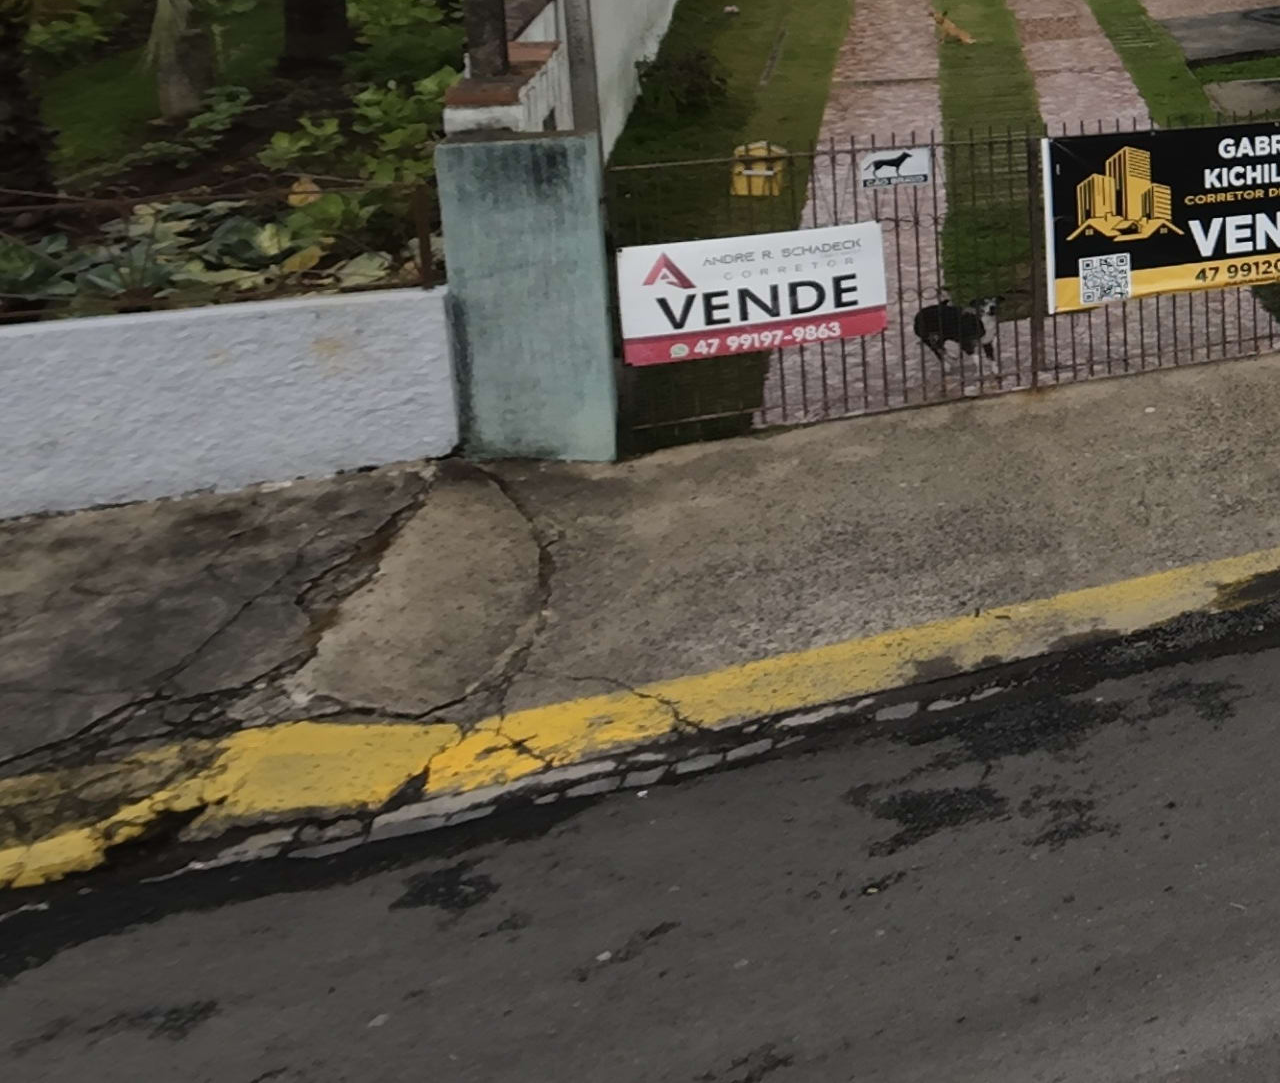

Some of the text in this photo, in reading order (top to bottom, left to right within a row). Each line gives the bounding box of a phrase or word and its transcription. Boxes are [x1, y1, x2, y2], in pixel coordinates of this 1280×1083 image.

[1184, 188, 1265, 205] CORRETOR
[702, 251, 756, 267] ANDRE
[781, 238, 862, 257] SCHADECK
[723, 257, 854, 281] CORRETOR
[1195, 266, 1220, 283] 47
[656, 273, 859, 330] VENDE
[694, 322, 842, 355] 47 99197-9863
